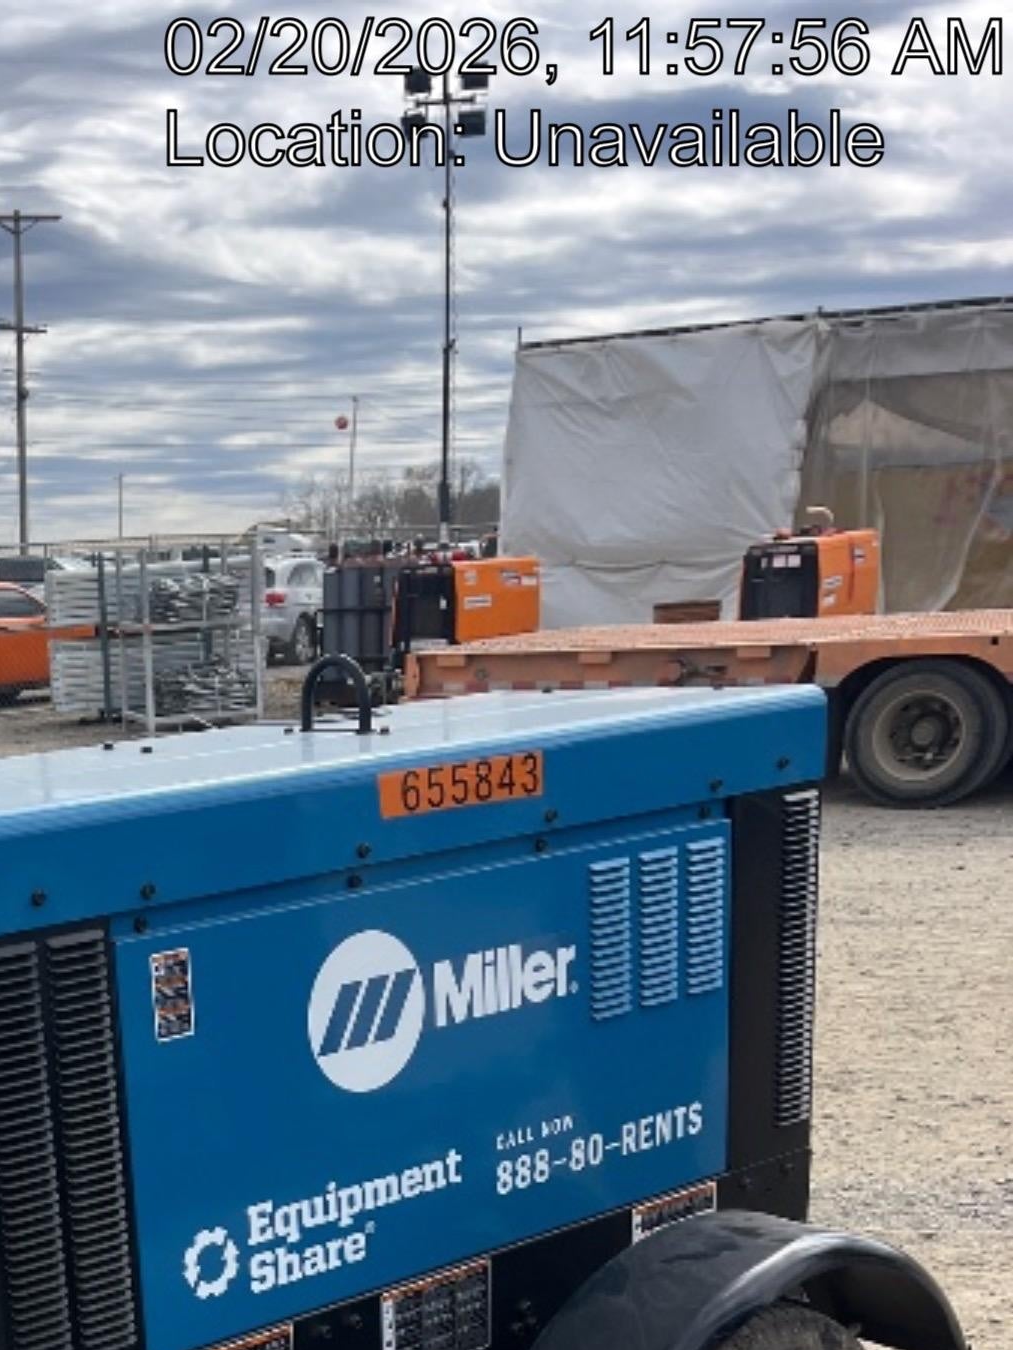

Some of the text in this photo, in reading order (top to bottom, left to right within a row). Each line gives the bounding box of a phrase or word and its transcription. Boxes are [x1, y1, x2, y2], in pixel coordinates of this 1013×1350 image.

[402, 752, 538, 811] 655843
[433, 944, 576, 1027] Miller
[496, 1114, 574, 1150] CALL NOW
[496, 1101, 703, 1195] 888-80-RENTS
[247, 1148, 462, 1246] Equipment
[250, 1231, 367, 1294] Share
